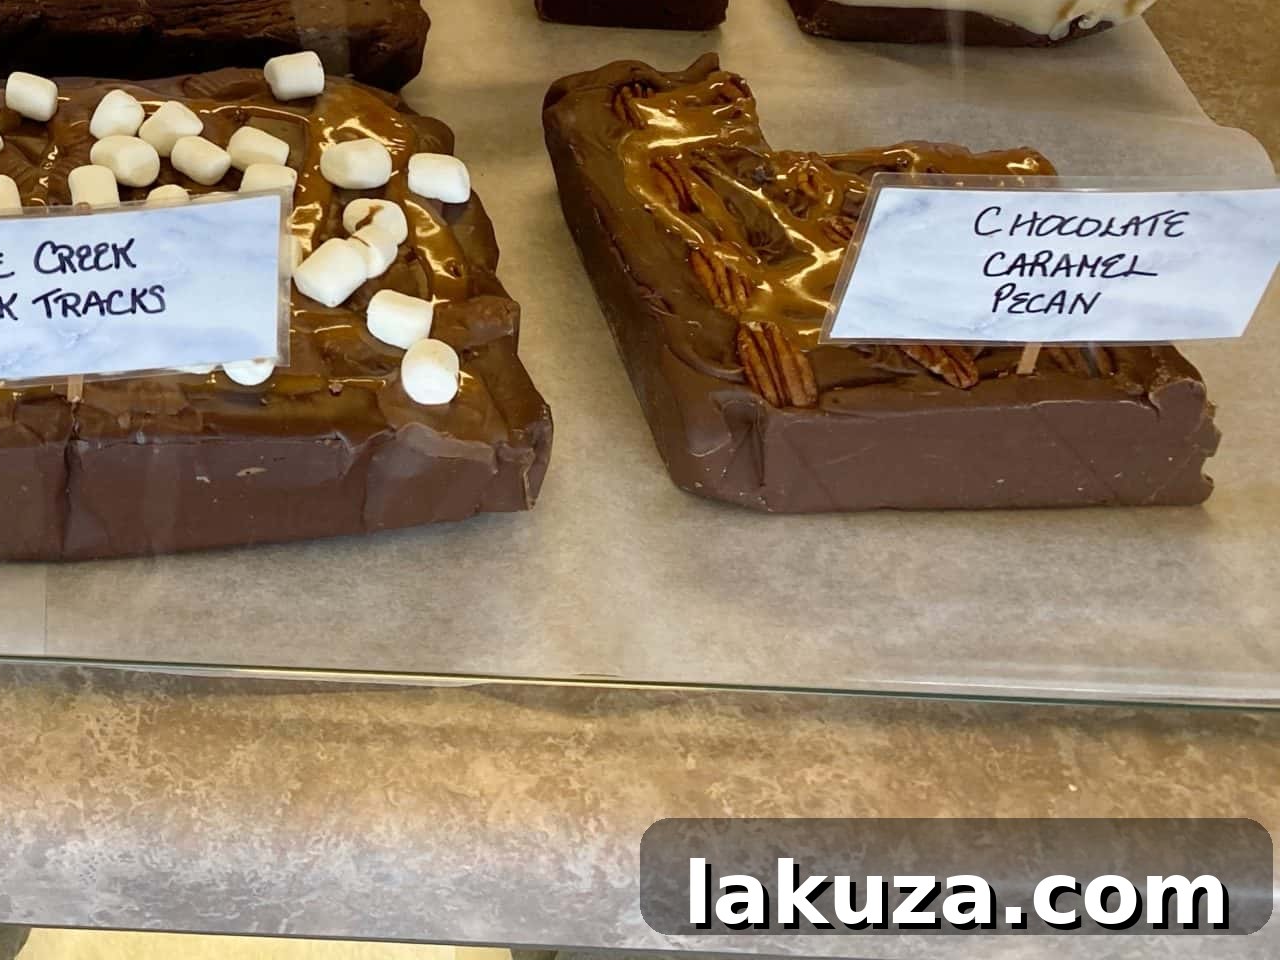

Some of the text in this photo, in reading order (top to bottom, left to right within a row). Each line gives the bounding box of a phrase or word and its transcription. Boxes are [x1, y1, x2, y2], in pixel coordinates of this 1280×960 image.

[974, 206, 1190, 238] CHOCOLATE
[33, 237, 137, 275] CREEK
[983, 249, 1158, 279] CARAMEL
[31, 284, 166, 319] TRACKS
[991, 282, 1102, 315] PECAN
